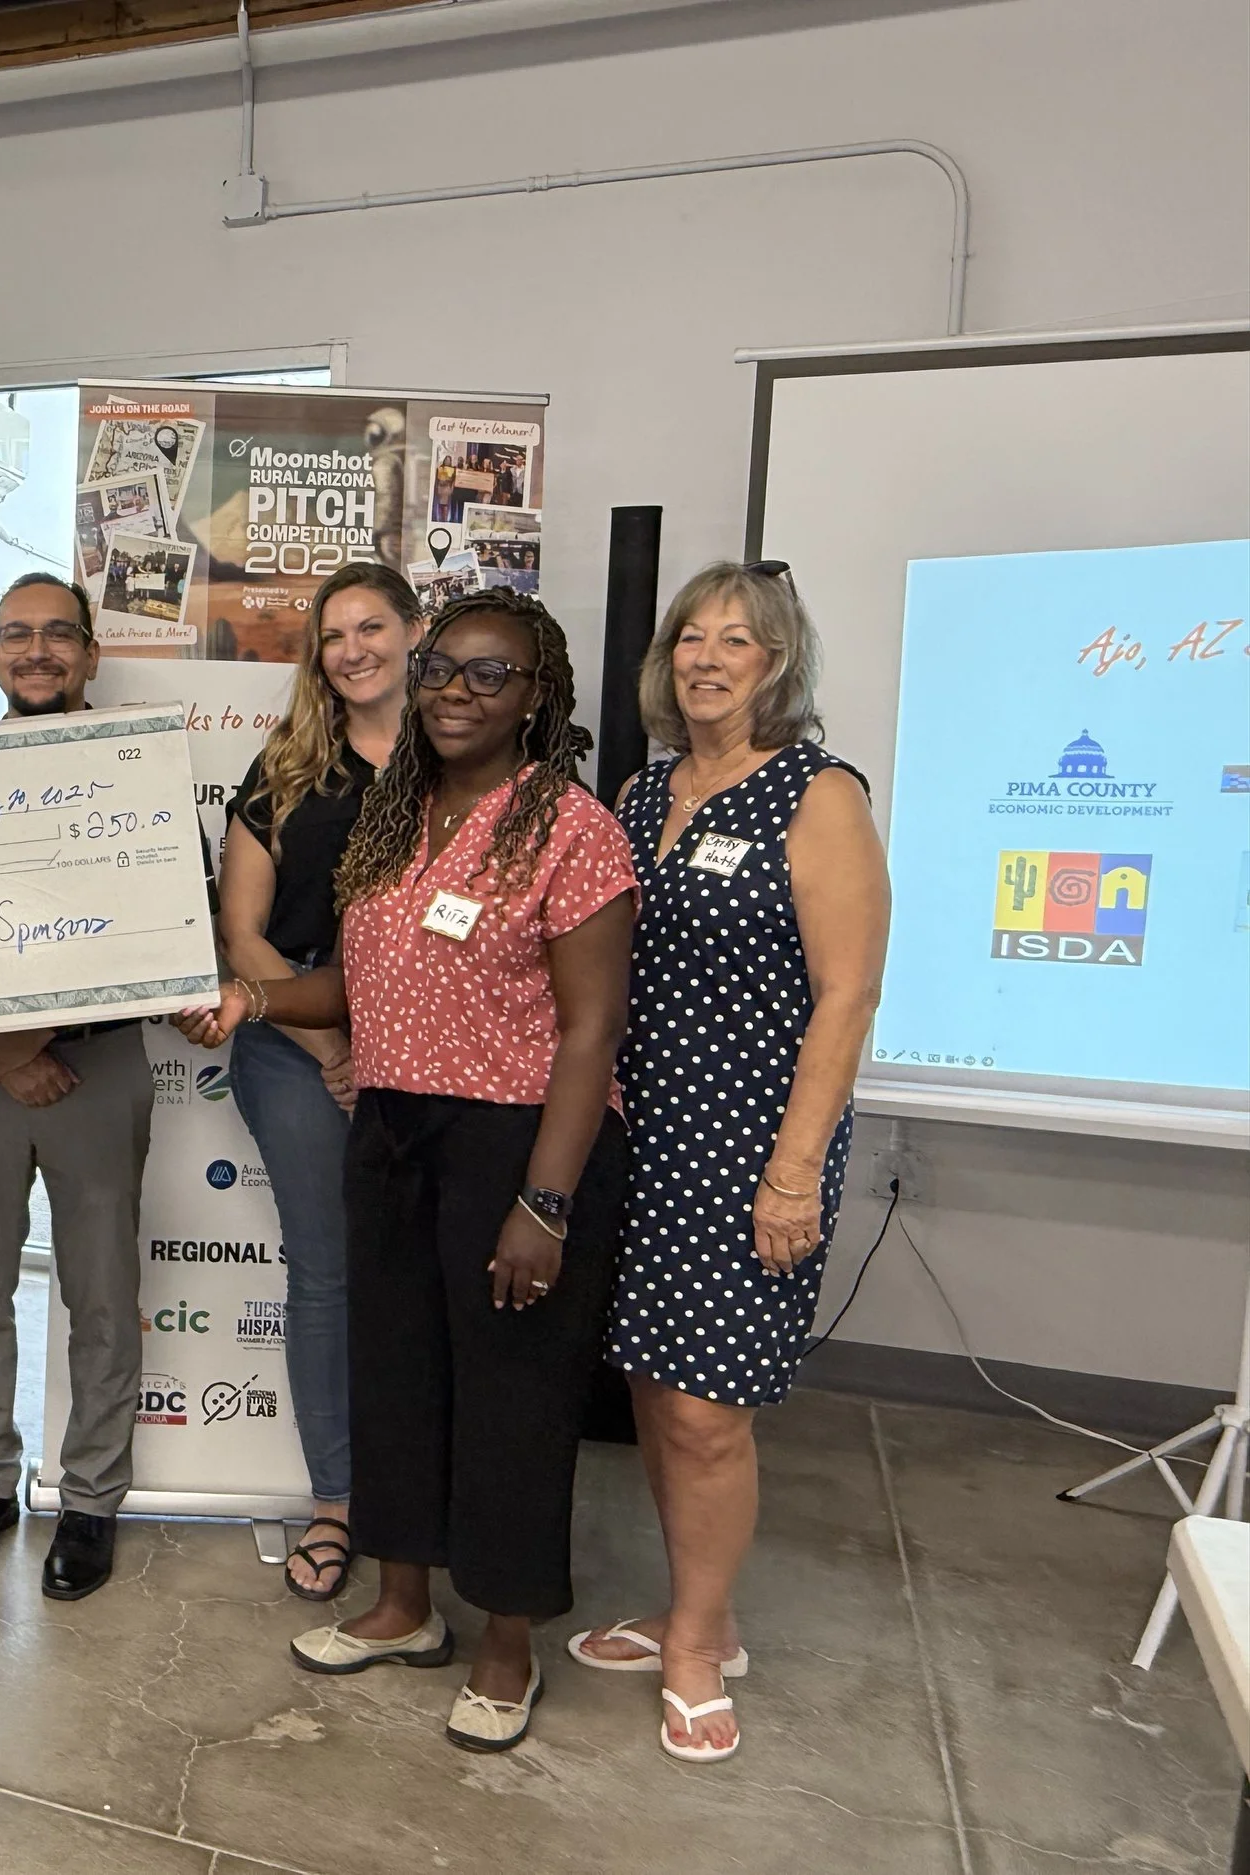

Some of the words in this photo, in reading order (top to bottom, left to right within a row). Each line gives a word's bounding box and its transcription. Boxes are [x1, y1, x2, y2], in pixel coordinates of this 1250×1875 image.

[90, 405, 111, 414] JOIN
[112, 404, 125, 414] US
[126, 404, 141, 414] ON
[142, 404, 160, 414] THE
[250, 446, 374, 471] Moonshot
[250, 469, 303, 485] RURAL
[306, 470, 376, 488] ARIZONA
[248, 486, 376, 528] PITCH
[246, 523, 374, 545] COMPETITION
[1077, 625, 1147, 677] Ajo,
[1167, 618, 1245, 661] AZ
[221, 705, 243, 731] to
[253, 712, 281, 731] ou
[118, 748, 142, 761] 022
[194, 784, 225, 806] UR
[1006, 782, 1061, 796] PIMA
[1066, 782, 1157, 797] COUNTY
[988, 803, 1064, 815] ECONOMIC
[1067, 805, 1174, 816] DEVELOPMENT
[1000, 933, 1136, 963] ISDA
[150, 1059, 185, 1077] wth
[241, 1164, 269, 1176] Arizo
[241, 1175, 272, 1187] Econo
[151, 1239, 273, 1264] REGIONAL
[154, 1300, 211, 1334] cic
[244, 1301, 286, 1318] TUCS
[237, 1318, 287, 1337] HISPA
[246, 1404, 277, 1417] LAB
